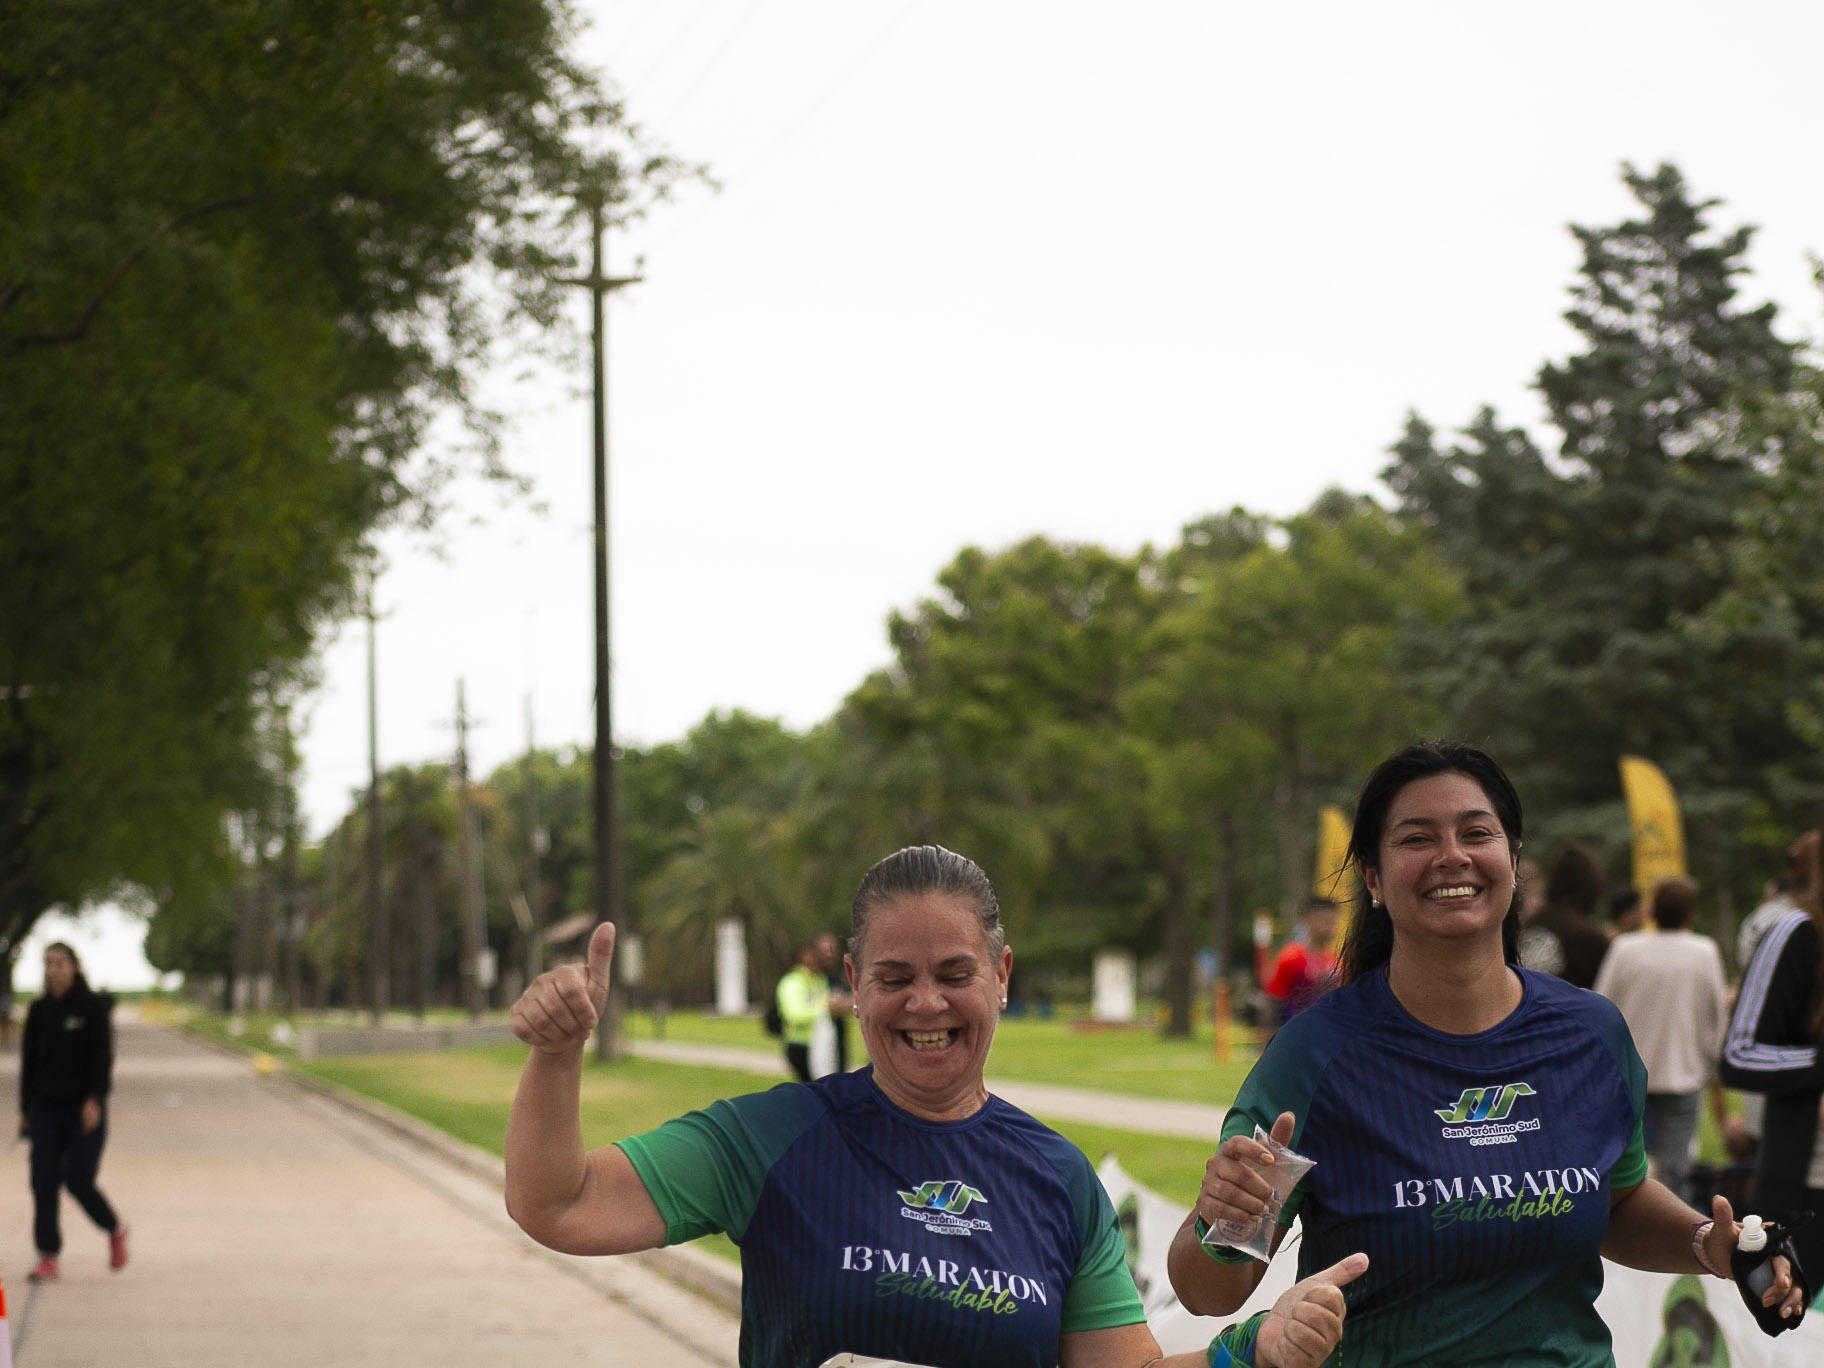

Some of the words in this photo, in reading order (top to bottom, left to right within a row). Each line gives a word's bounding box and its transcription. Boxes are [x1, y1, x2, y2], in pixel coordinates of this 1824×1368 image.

[1442, 1128, 1463, 1138] San
[1464, 1123, 1516, 1137] Jerónimo
[1518, 1118, 1541, 1131] Sud
[1470, 1134, 1517, 1146] COMUNA
[901, 1208, 921, 1220] San
[1431, 1187, 1574, 1231] Saludable
[926, 1224, 971, 1236] COMUNA
[874, 1271, 1019, 1315] Saludable
